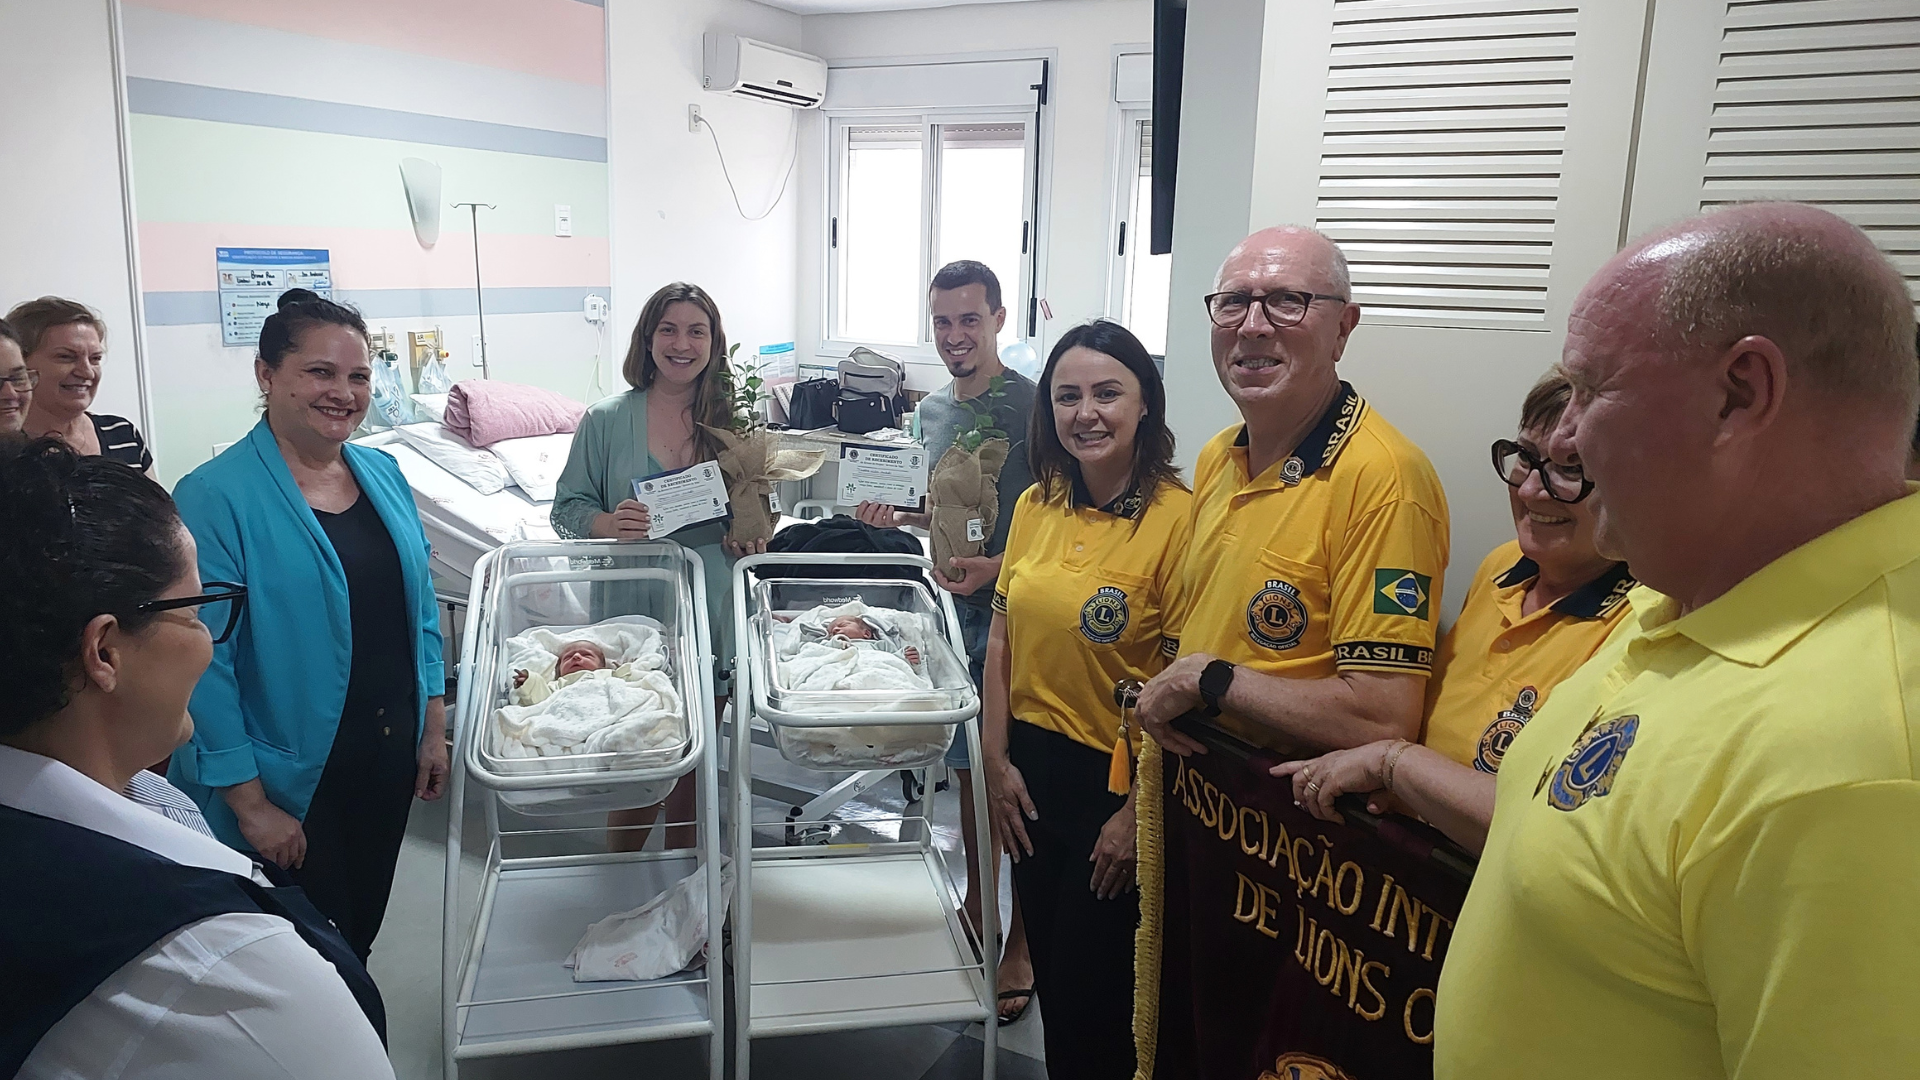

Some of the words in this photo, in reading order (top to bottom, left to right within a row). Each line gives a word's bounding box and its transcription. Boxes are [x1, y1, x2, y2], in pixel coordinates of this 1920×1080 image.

[1321, 394, 1358, 459] BRASIL
[1099, 587, 1124, 598] BRASIL
[1266, 580, 1296, 596] BRASIL
[1097, 597, 1120, 609] LIONS
[1264, 594, 1292, 607] LIONS
[1098, 607, 1110, 622] L
[1269, 606, 1283, 625] L
[1578, 740, 1612, 781] L
[1172, 755, 1365, 916] ASSOCIAÇÃO
[1233, 871, 1281, 939] DE
[1295, 904, 1391, 1021] LIONS
